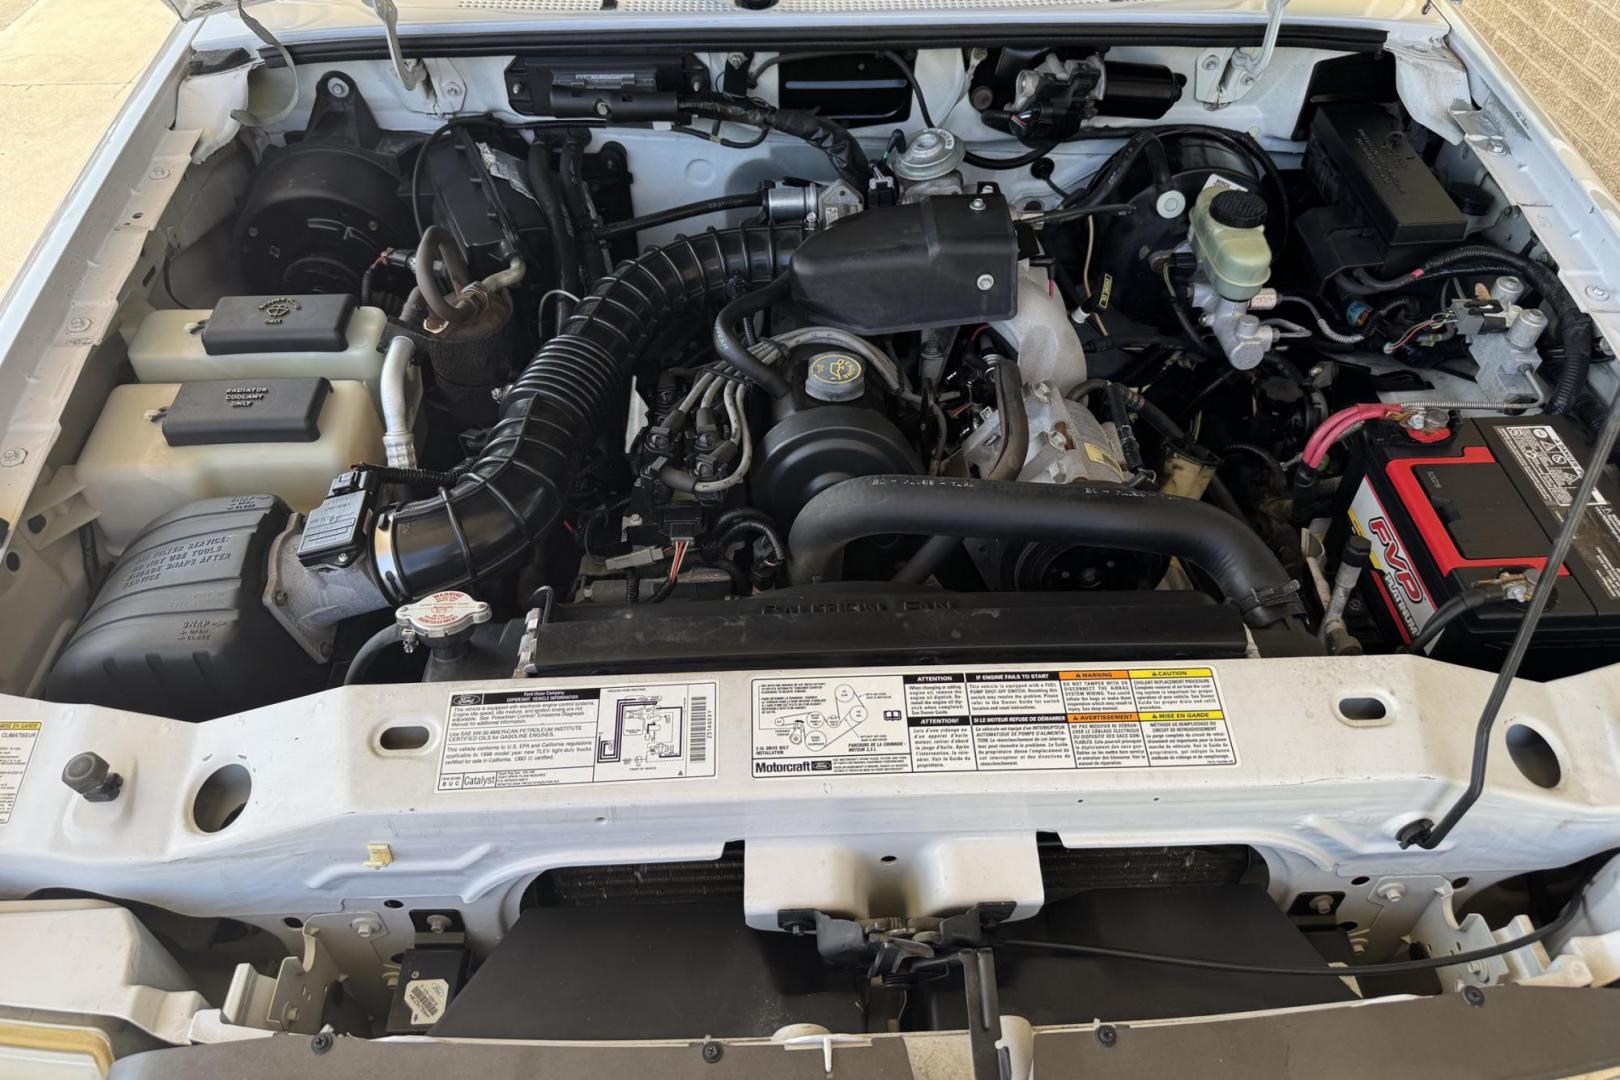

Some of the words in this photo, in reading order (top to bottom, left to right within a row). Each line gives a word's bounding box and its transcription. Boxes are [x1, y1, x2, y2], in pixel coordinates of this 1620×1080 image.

[166, 559, 197, 571] SNAPS
[200, 553, 232, 565] AFTER
[170, 552, 189, 562] USE
[193, 546, 223, 558] TOOLS
[1368, 516, 1424, 604] FVP
[122, 573, 162, 590] SERVICE
[1384, 571, 1420, 637] PLATINUM
[183, 620, 210, 628] SNAP
[755, 760, 810, 772] Motorcraft
[463, 774, 495, 786] Catalyst
